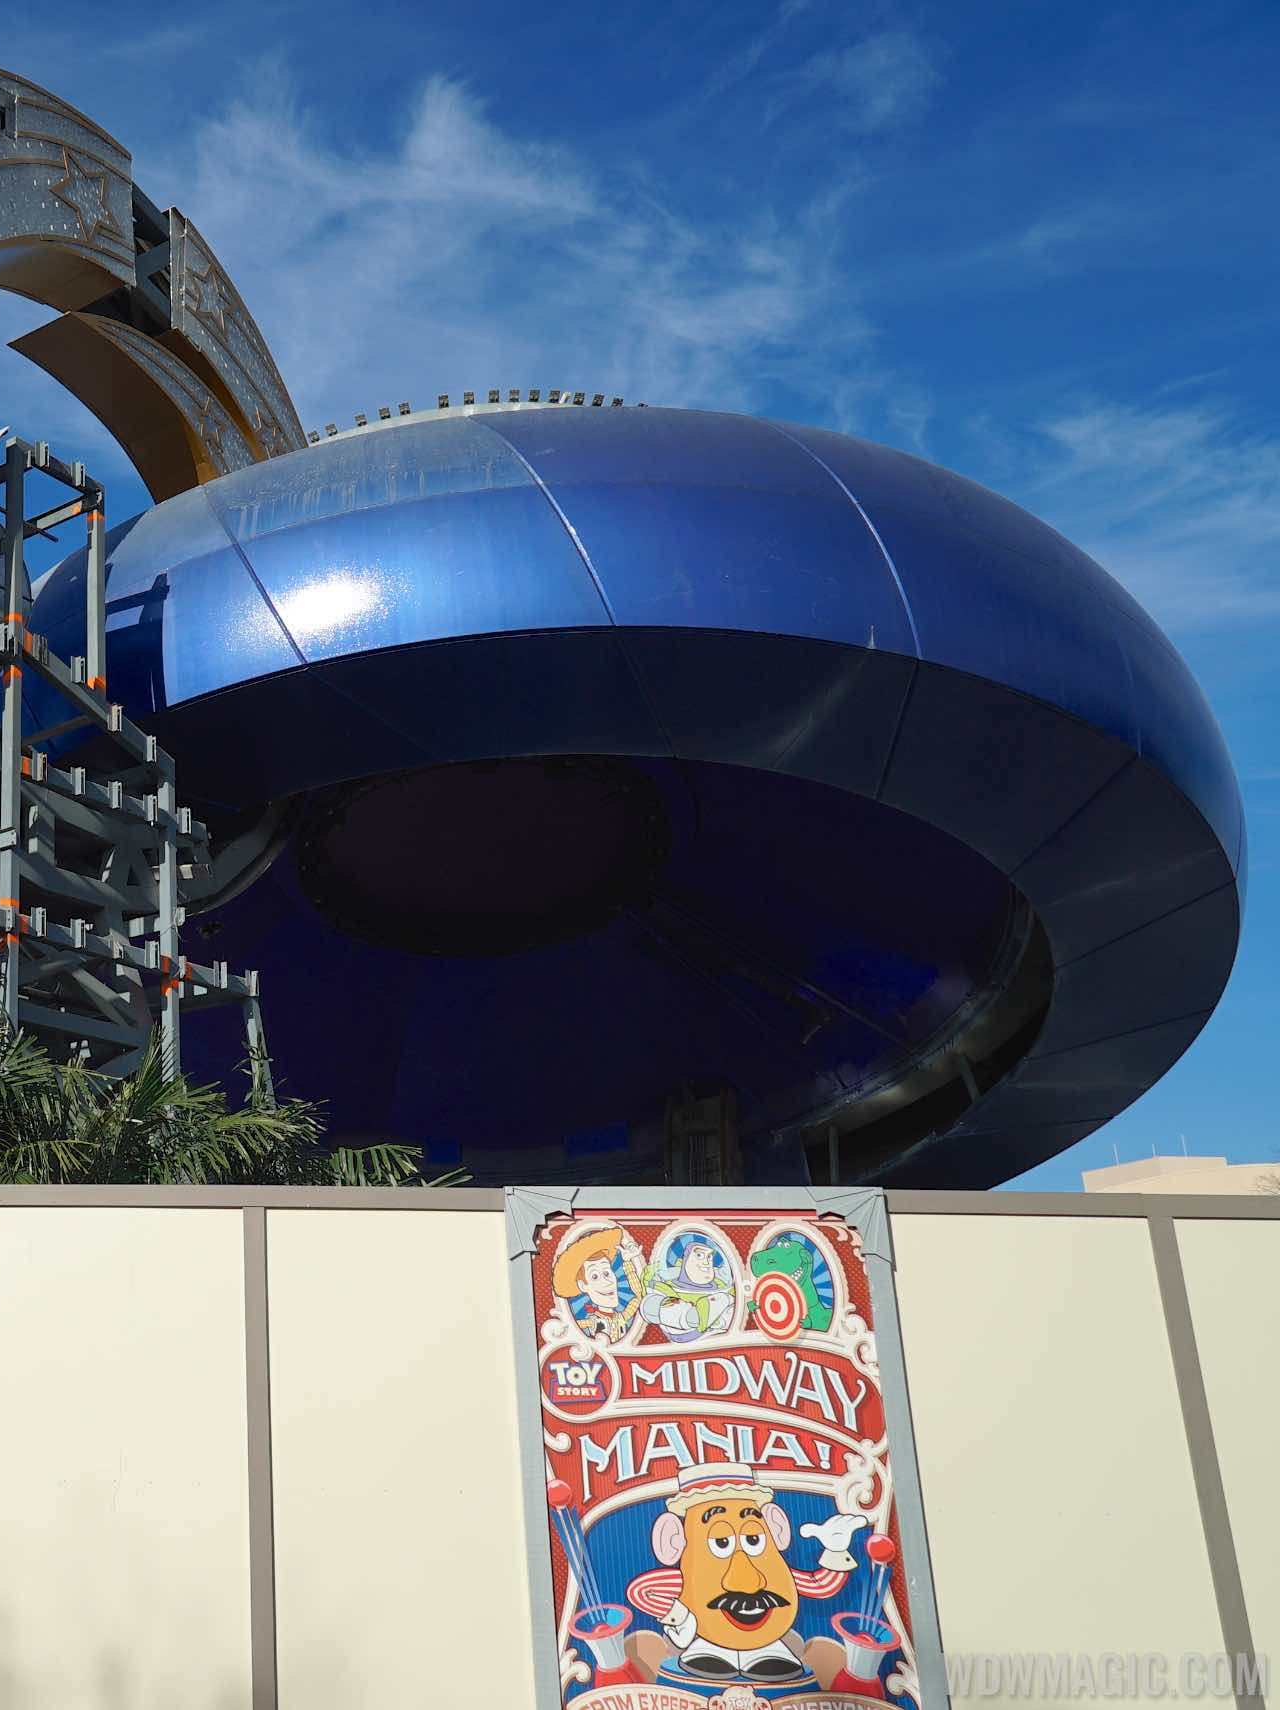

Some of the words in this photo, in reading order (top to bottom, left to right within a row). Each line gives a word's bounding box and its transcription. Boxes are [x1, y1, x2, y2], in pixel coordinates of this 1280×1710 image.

[549, 1362, 603, 1386] TOY
[557, 1386, 599, 1396] STORY
[631, 1351, 866, 1433] MIDWAY
[578, 1421, 833, 1503] MANIA!
